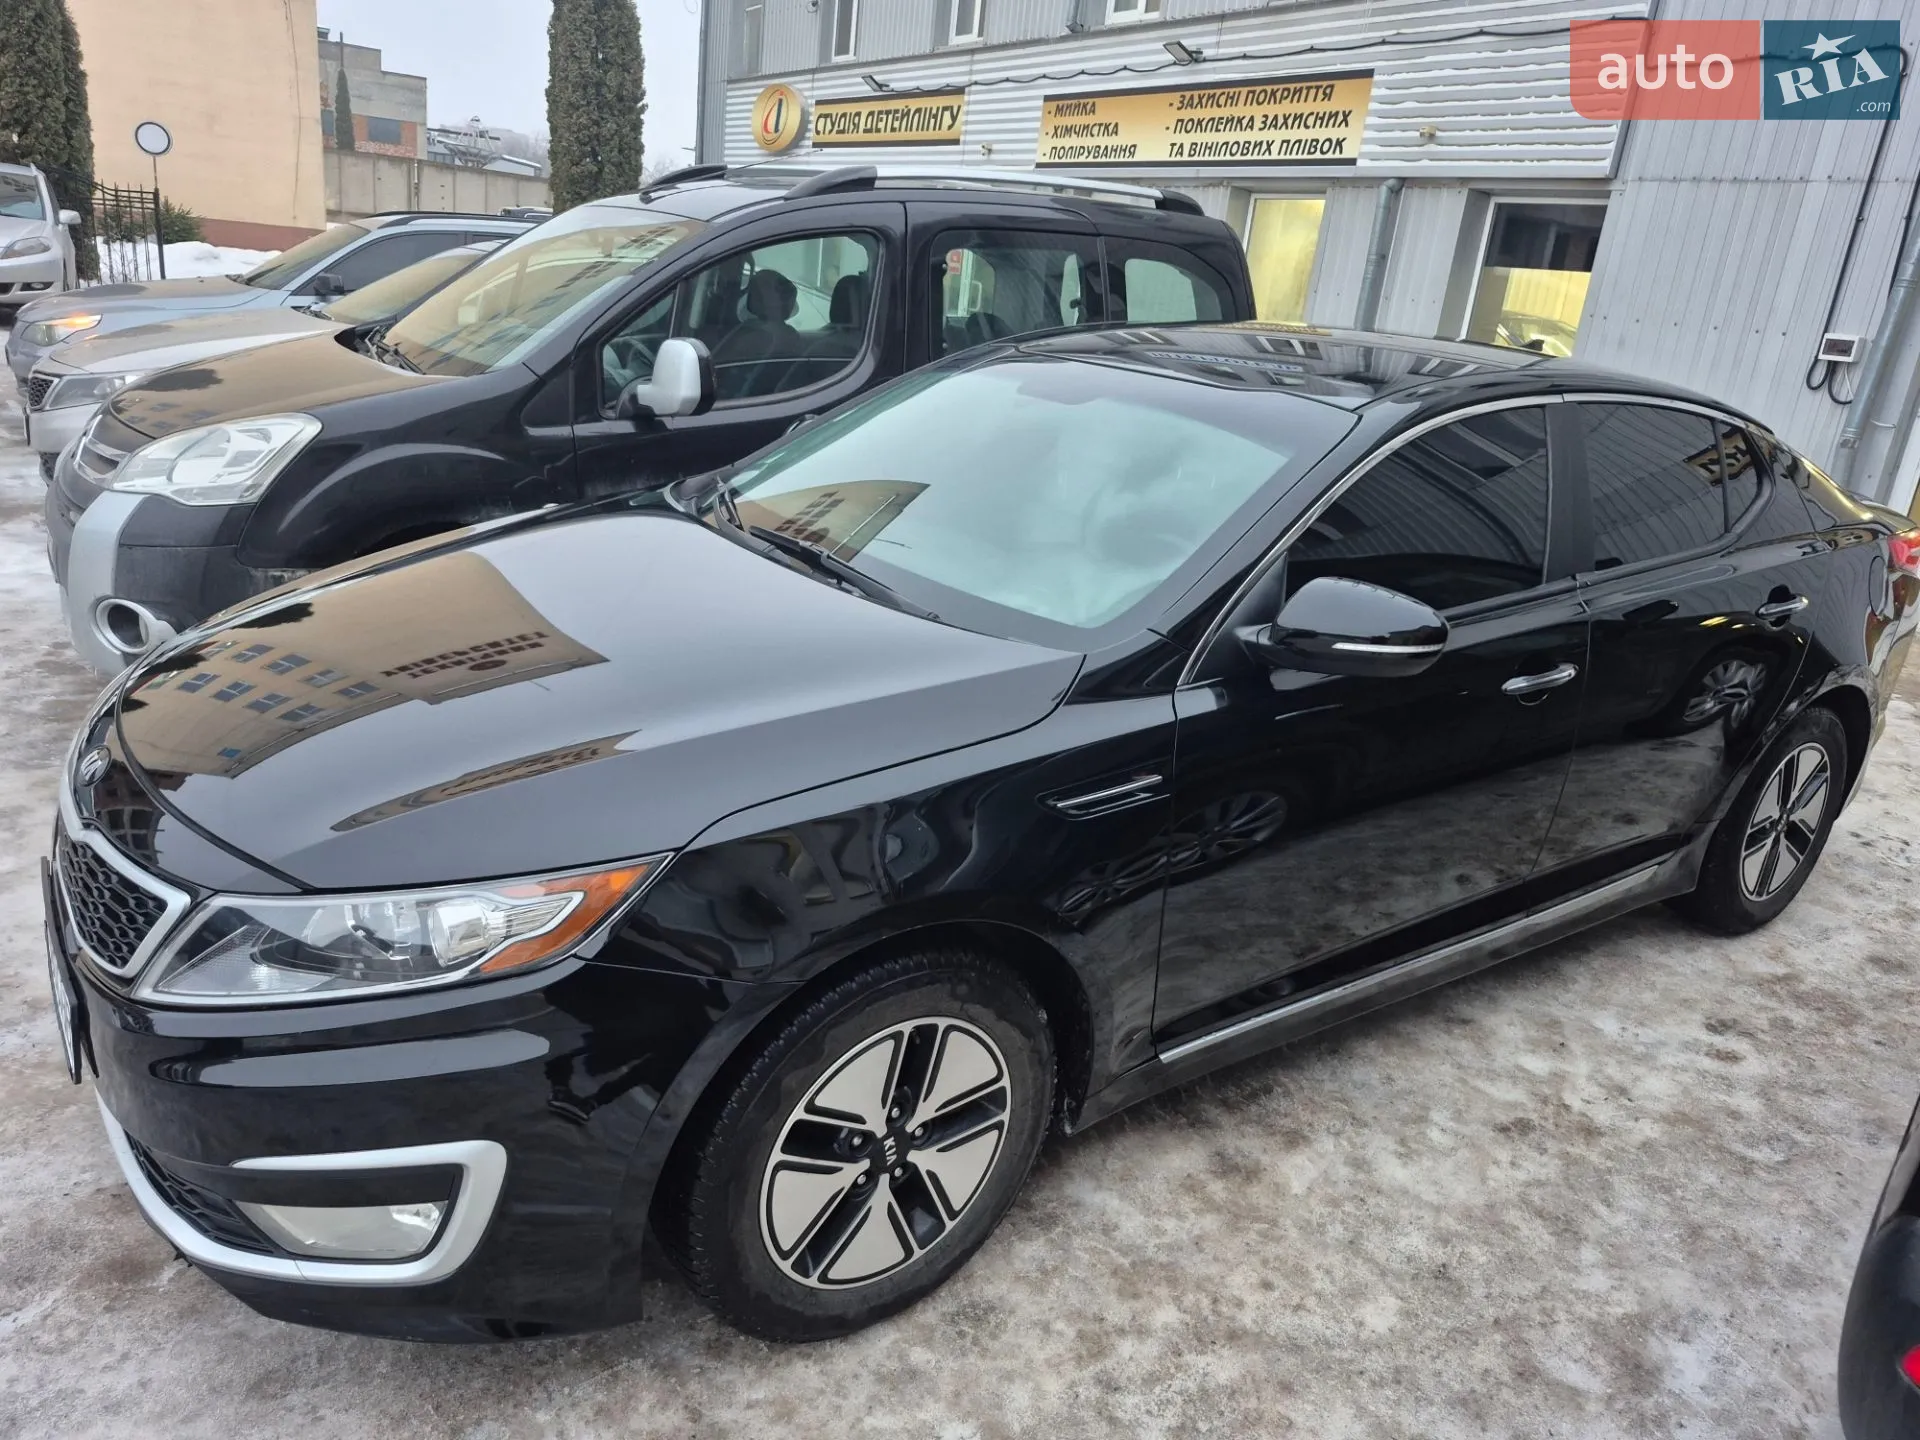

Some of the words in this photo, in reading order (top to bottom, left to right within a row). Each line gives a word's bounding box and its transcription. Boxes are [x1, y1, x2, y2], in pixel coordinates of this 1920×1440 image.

[1177, 90, 1241, 111] ЗАХИСНІ
[1243, 83, 1335, 107] ПОКРИТТЯ
[815, 111, 862, 136] СТУДІЯ
[863, 104, 962, 134] ДЕТЕЙЛІНГУ
[1054, 101, 1096, 118] МИЙКА
[1051, 122, 1119, 139] ХІМЧИСТКА
[1173, 113, 1255, 135] ПОКЛЕЙКА
[1259, 110, 1353, 131] ЗАХИСНИХ
[1049, 144, 1138, 160] ПОЛІРУВАННЯ
[1168, 142, 1184, 158] ТА
[1188, 139, 1275, 158] ВІНІЛОВИХ
[1277, 137, 1348, 157] ПЛІВОК
[883, 1136, 897, 1166] KIA
